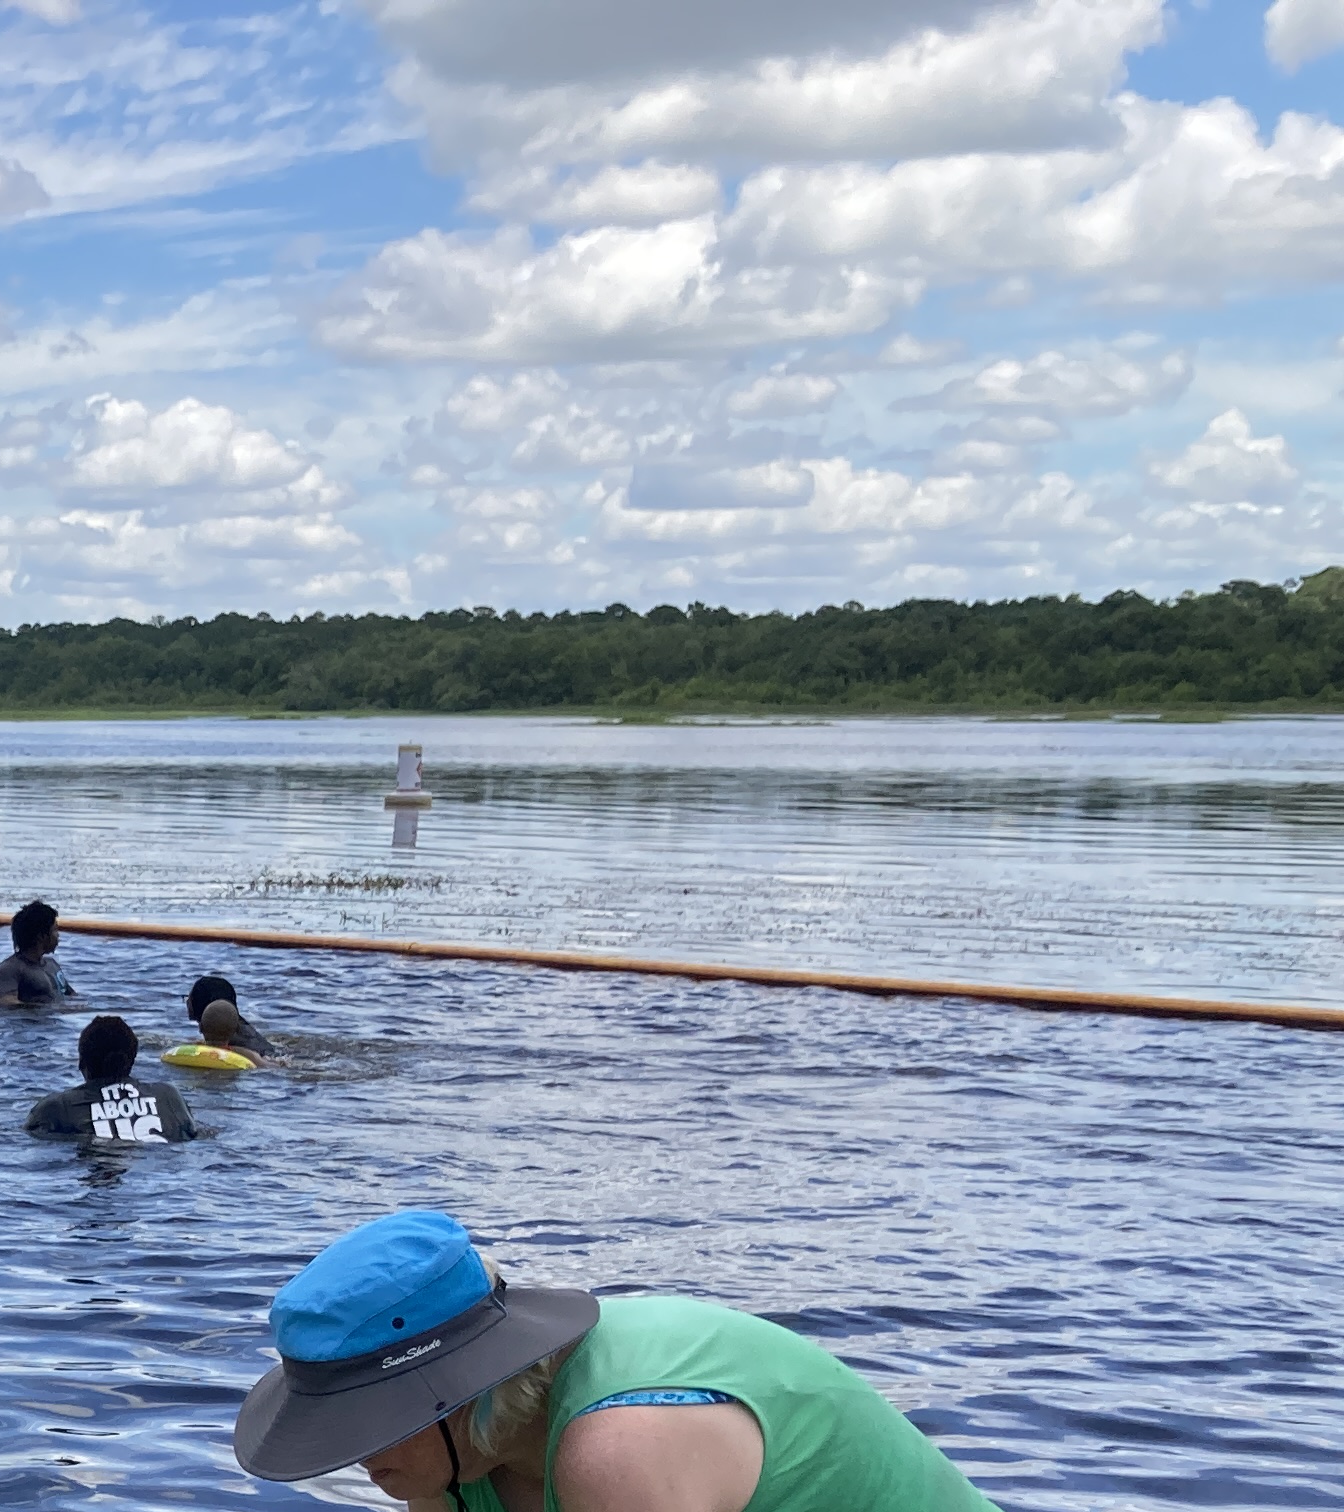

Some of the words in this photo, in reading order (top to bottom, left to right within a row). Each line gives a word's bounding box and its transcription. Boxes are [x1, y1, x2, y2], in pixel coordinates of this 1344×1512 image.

[100, 1083, 140, 1101] IT'S
[90, 1096, 159, 1121] ABOUT
[381, 1338, 442, 1369] SunShade
